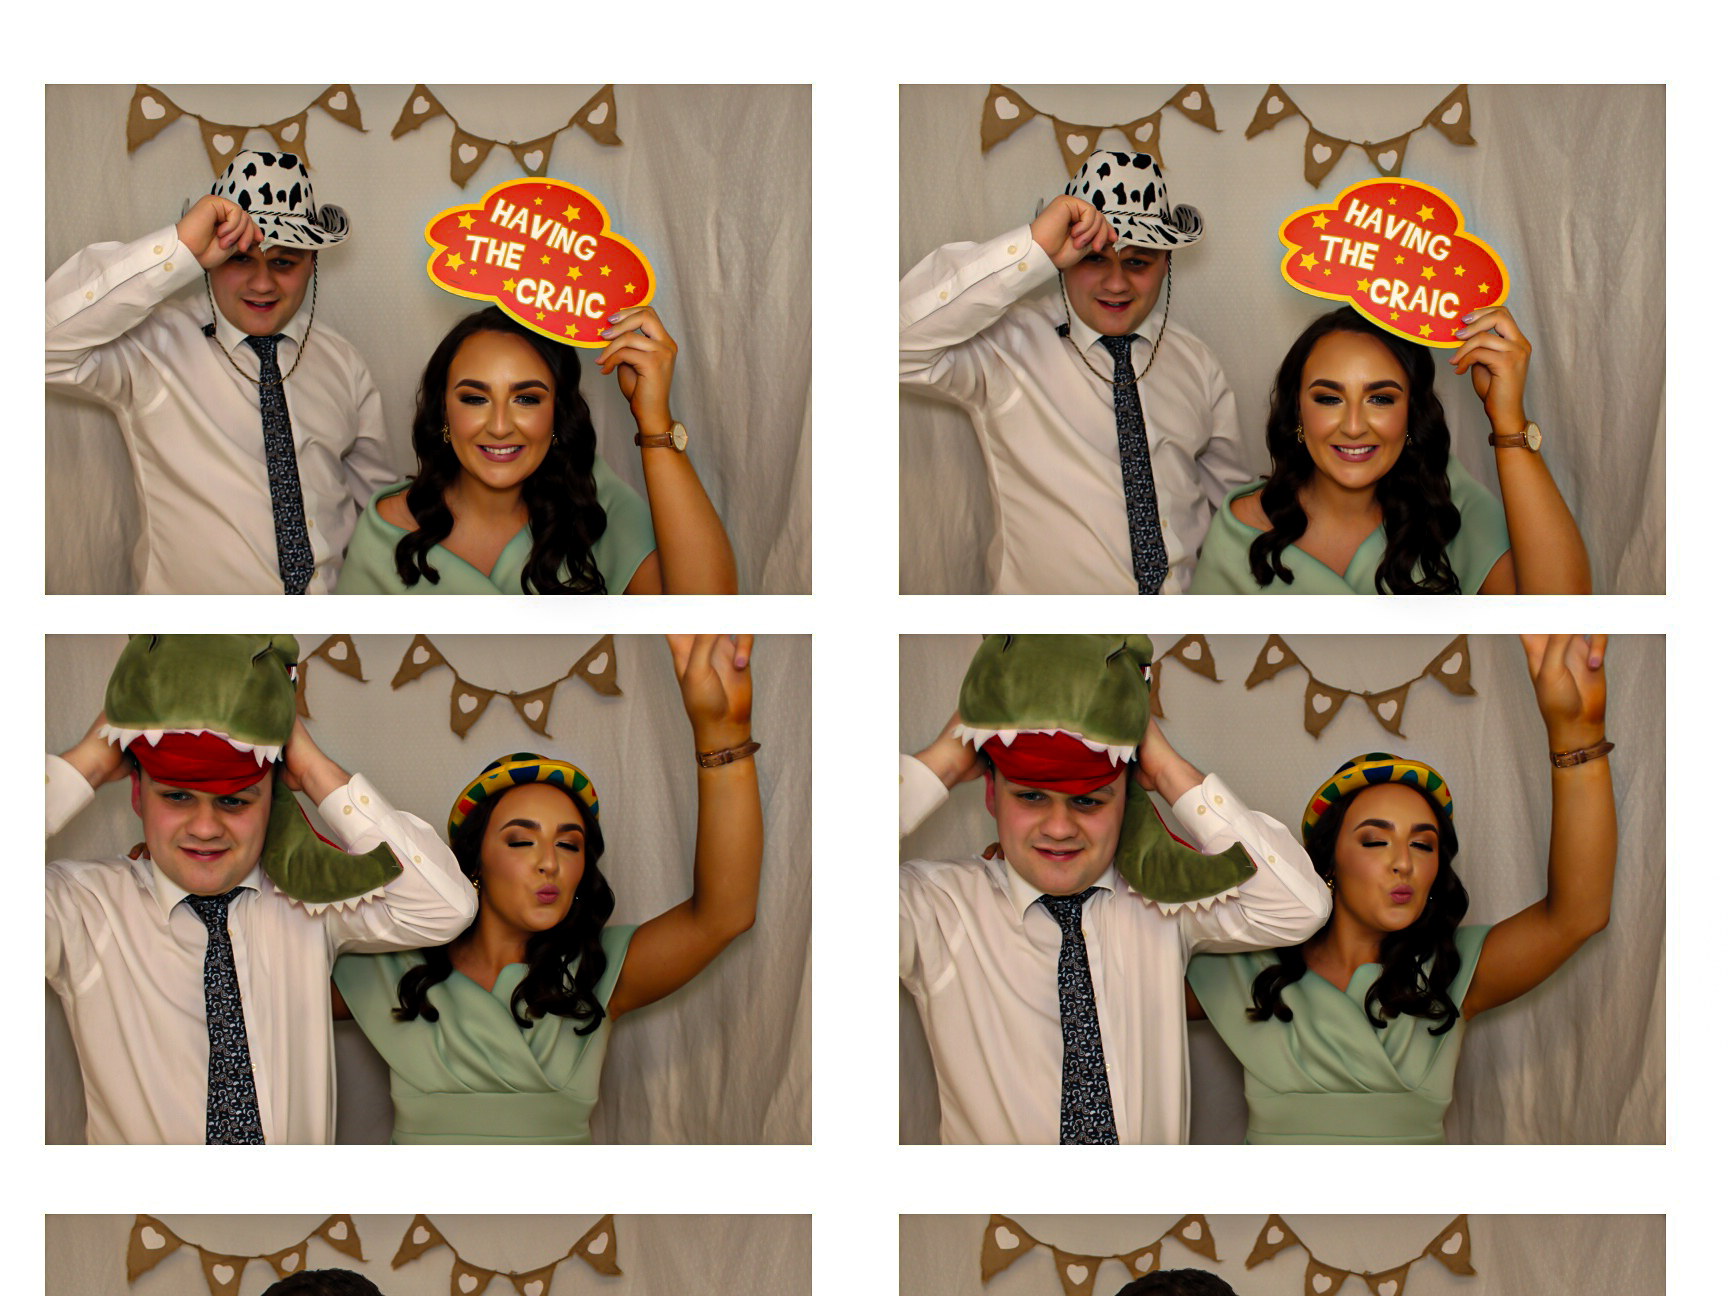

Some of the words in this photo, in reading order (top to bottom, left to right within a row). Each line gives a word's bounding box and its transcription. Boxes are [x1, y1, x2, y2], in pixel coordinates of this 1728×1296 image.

[489, 198, 598, 262] HAVING
[1343, 198, 1452, 262] HAVING
[465, 234, 526, 271] THE
[1319, 234, 1380, 271] THE
[515, 277, 607, 319] CRAIC
[1369, 277, 1461, 319] CRAIC
